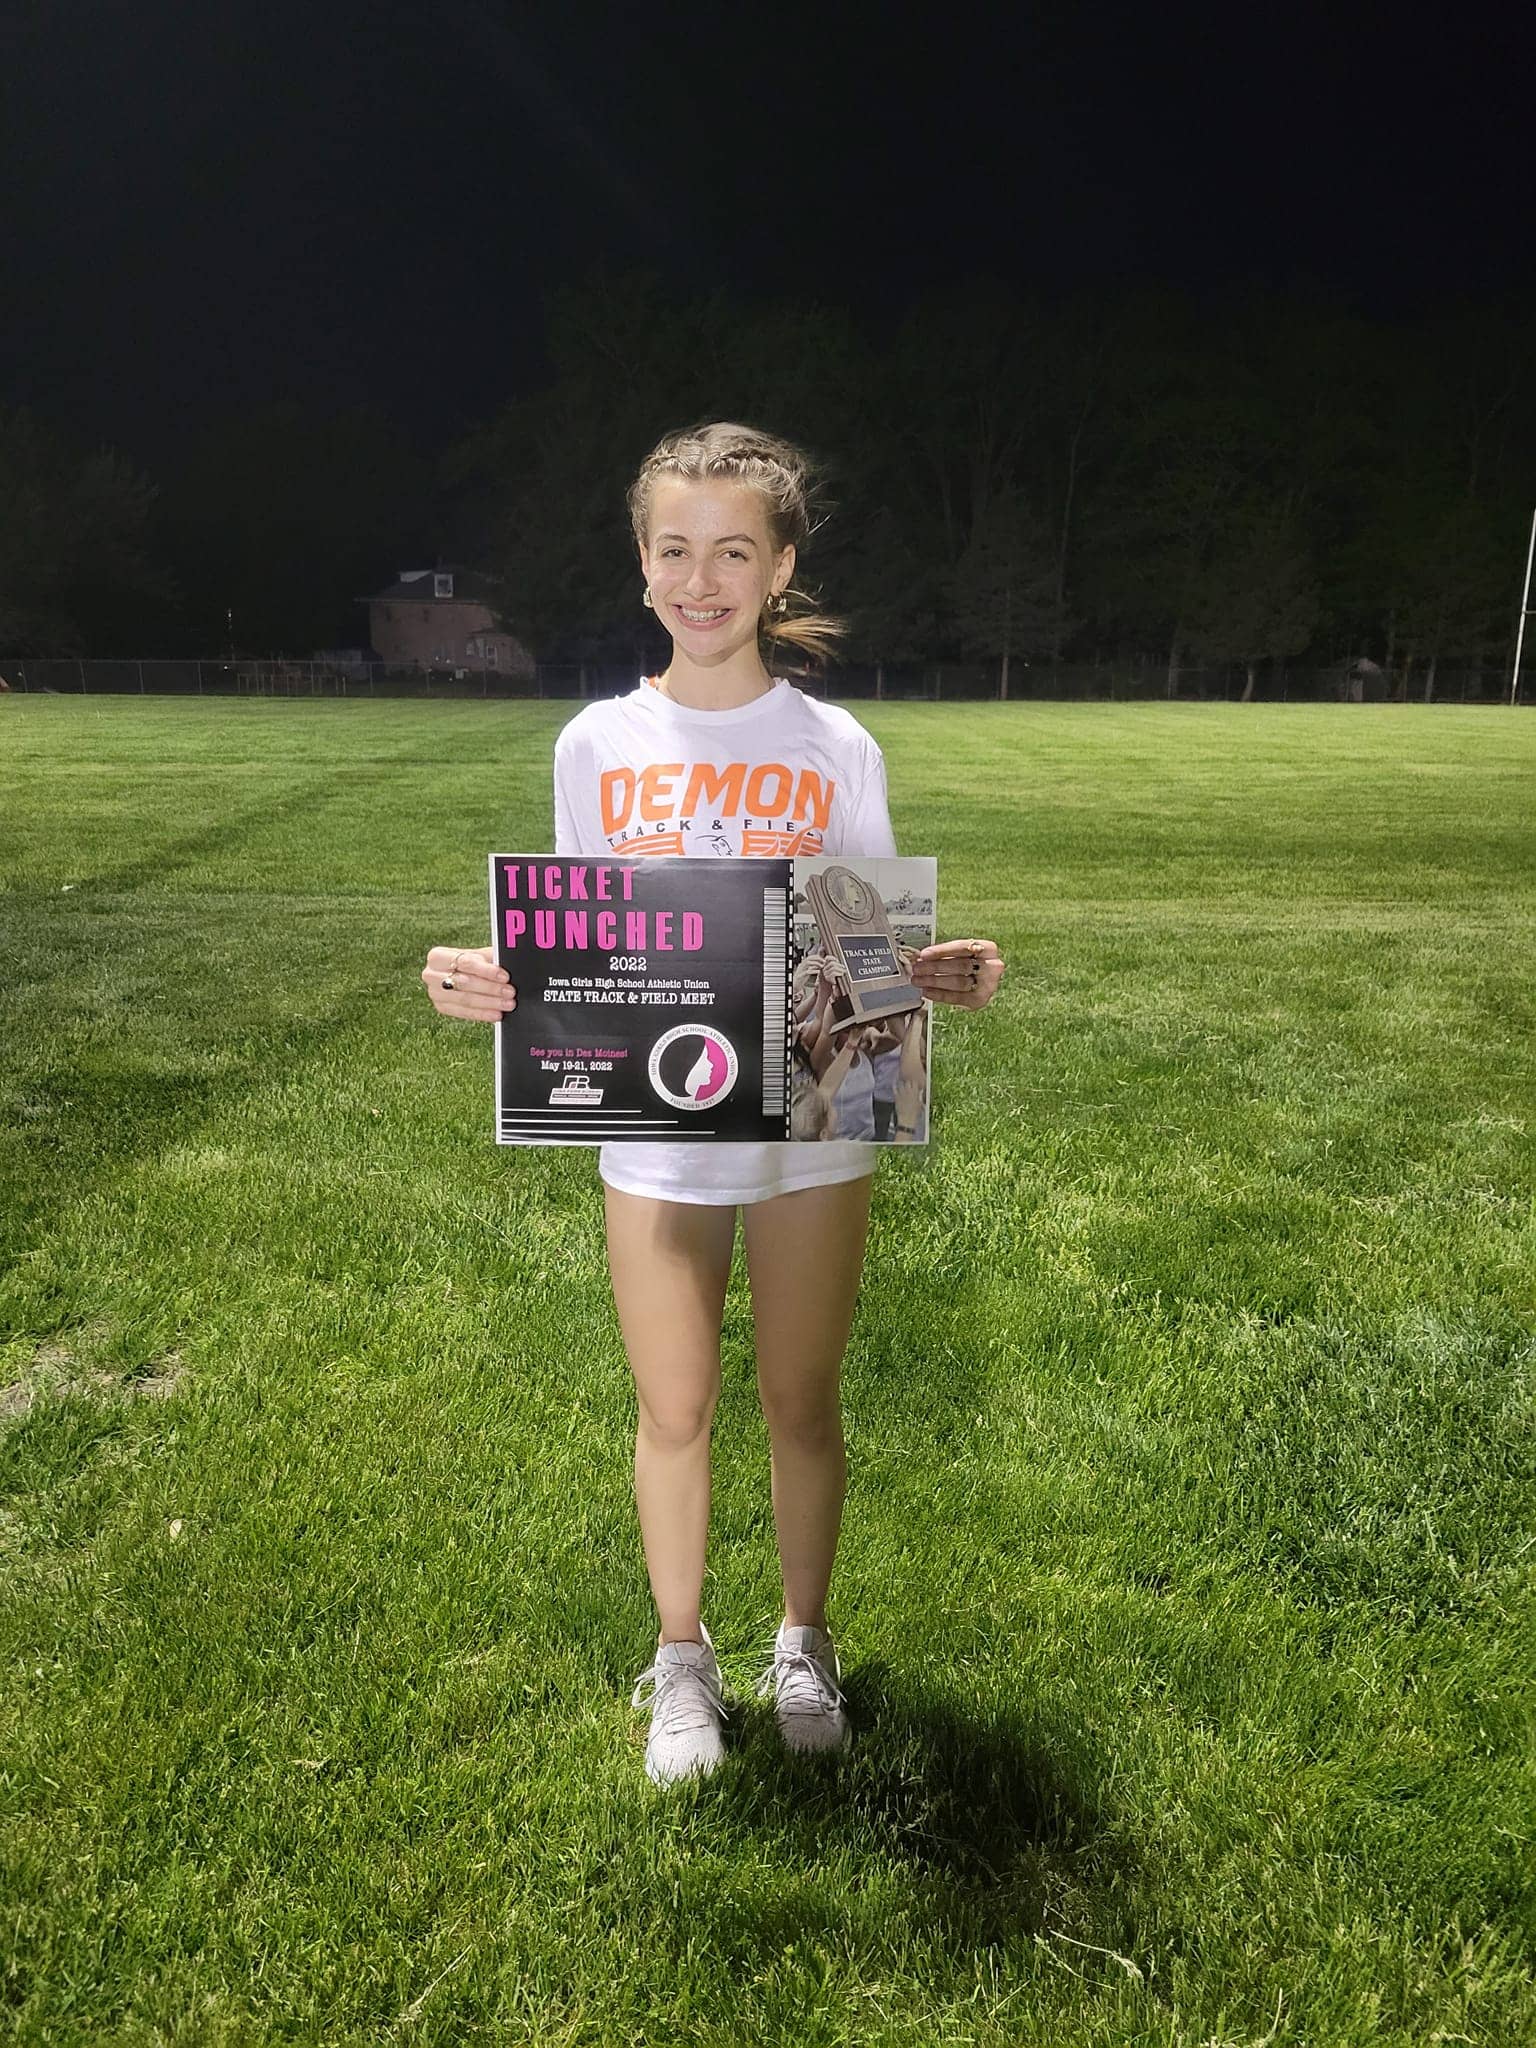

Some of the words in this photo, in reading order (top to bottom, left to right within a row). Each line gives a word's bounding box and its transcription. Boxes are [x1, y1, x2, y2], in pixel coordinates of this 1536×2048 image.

[600, 763, 836, 836] DEMON
[607, 820, 692, 847] TRACK
[711, 819, 723, 830] &
[743, 819, 823, 843] FIE
[503, 865, 636, 900] TICKET
[505, 909, 704, 951] PUNCHED
[843, 949, 868, 958] TRACK
[868, 948, 874, 956] &
[874, 948, 892, 956] FIELD
[609, 956, 647, 971] 2022
[862, 957, 882, 966] STATE
[548, 977, 570, 987] Iowa
[571, 977, 593, 987] Girls
[595, 978, 616, 990] High
[617, 978, 645, 988] School
[647, 979, 682, 989] Athletic
[683, 979, 710, 989] Union
[543, 990, 581, 1002] STATE
[584, 991, 625, 1004] TRACK
[627, 992, 639, 1004] &
[640, 992, 678, 1005] FIELD
[680, 993, 716, 1005] MEET
[530, 1047, 545, 1057] See
[547, 1049, 563, 1058] you
[565, 1048, 574, 1057] in
[576, 1048, 592, 1057] Des
[595, 1048, 628, 1058] Moines!
[541, 1060, 560, 1072] May
[562, 1061, 588, 1072] 19-21,
[589, 1061, 613, 1071] 2022
